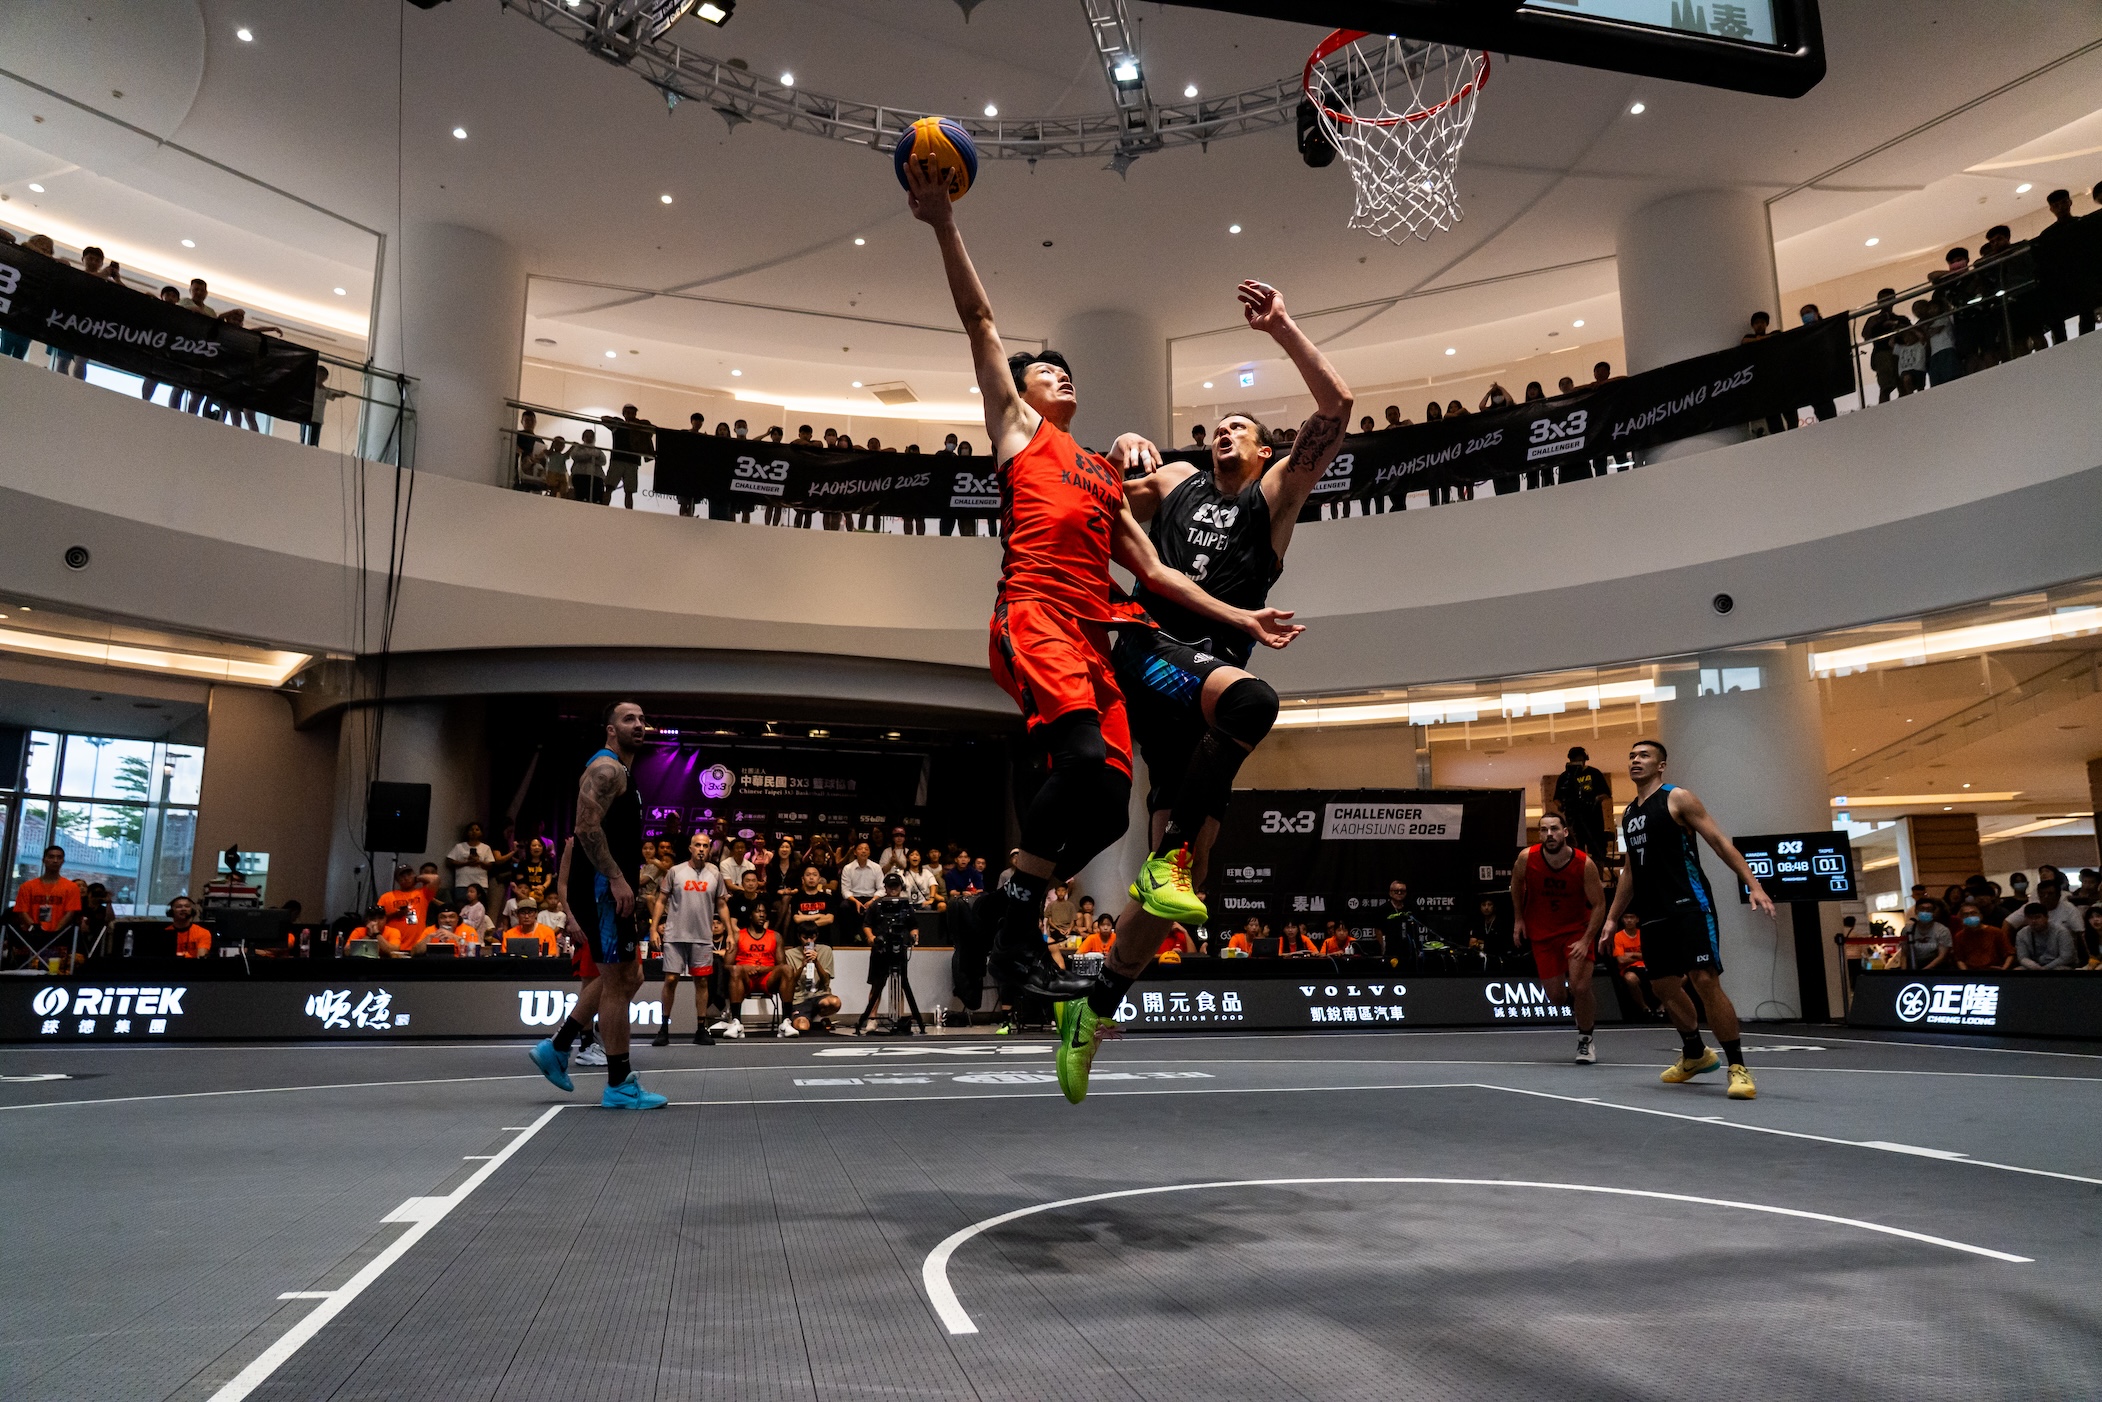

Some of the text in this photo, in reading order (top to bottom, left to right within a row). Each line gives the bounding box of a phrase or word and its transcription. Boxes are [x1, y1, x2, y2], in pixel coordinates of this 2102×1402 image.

[46, 308, 221, 358] KAOHSIUNG 2025
[1611, 365, 1755, 440] KAOHSIUNG 2025
[1531, 439, 1581, 457] CHALLENGER
[1375, 442, 1462, 484] KAOHSIUNG
[1465, 429, 1504, 455] 2025
[735, 482, 780, 493] CHALLENGER
[808, 472, 931, 497] KAOHSIUNG 2025
[954, 498, 997, 506] CHALLENGER
[1086, 505, 1106, 534] 2
[1185, 554, 1210, 582] 3
[740, 774, 787, 789] 中華民國
[1334, 808, 1422, 820] CHALLENGER
[1332, 823, 1447, 835] KAOHSIUNG 2025
[1637, 847, 1645, 866] 7
[1777, 861, 1809, 873] 08:48
[1819, 859, 1839, 872] 01
[1223, 898, 1266, 909] Wilson
[1292, 896, 1326, 912] 泰山
[1299, 985, 1407, 997] VOLVO
[1142, 990, 1243, 1013] 開元食品
[1928, 984, 2000, 1016] 正隆
[1310, 1005, 1405, 1022] 凱銳南區汽車
[1494, 1005, 1573, 1018] 誠美材料科技
[1926, 1015, 1997, 1026] CHENG LOONG
